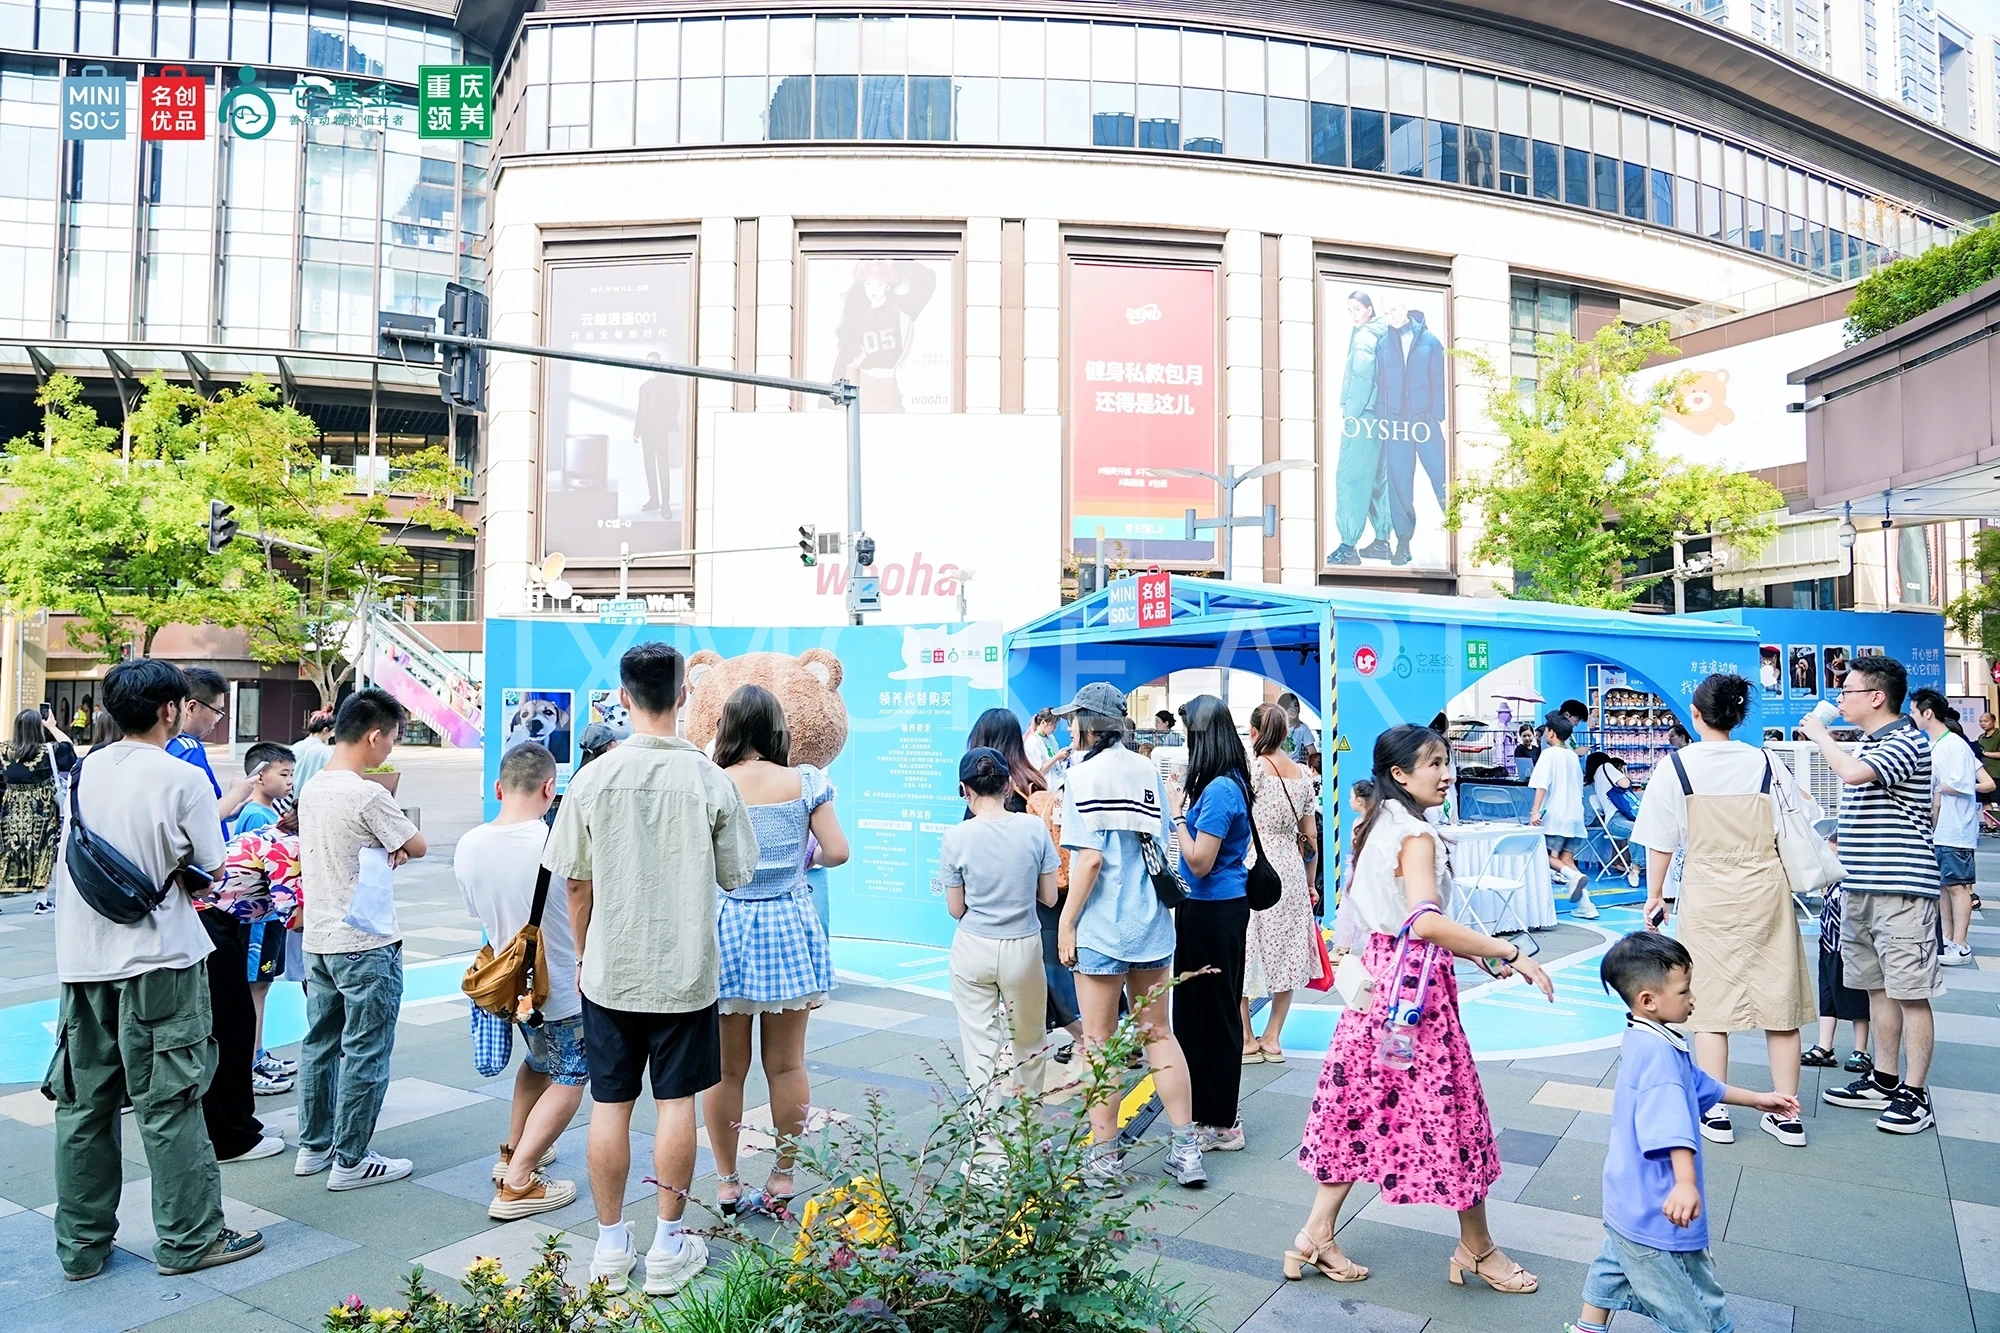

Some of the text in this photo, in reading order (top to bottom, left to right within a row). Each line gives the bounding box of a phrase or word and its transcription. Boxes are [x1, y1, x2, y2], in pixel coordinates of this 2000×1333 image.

[571, 328, 668, 341] 开启全智能时代
[1085, 360, 1203, 386] 健身私教包月
[911, 394, 949, 406] wooha
[1095, 390, 1195, 416] 还得是这儿
[1342, 416, 1431, 443] OYSHO
[816, 551, 960, 597] woha
[1110, 585, 1136, 603] MINI
[1142, 580, 1166, 600] 名创
[646, 593, 692, 611] Walk
[1142, 601, 1167, 621] 优品
[1416, 652, 1454, 666] 它基金
[1911, 648, 1939, 661] 开心世界
[879, 691, 952, 707] 领养代替购买
[901, 723, 931, 733] 领养要求
